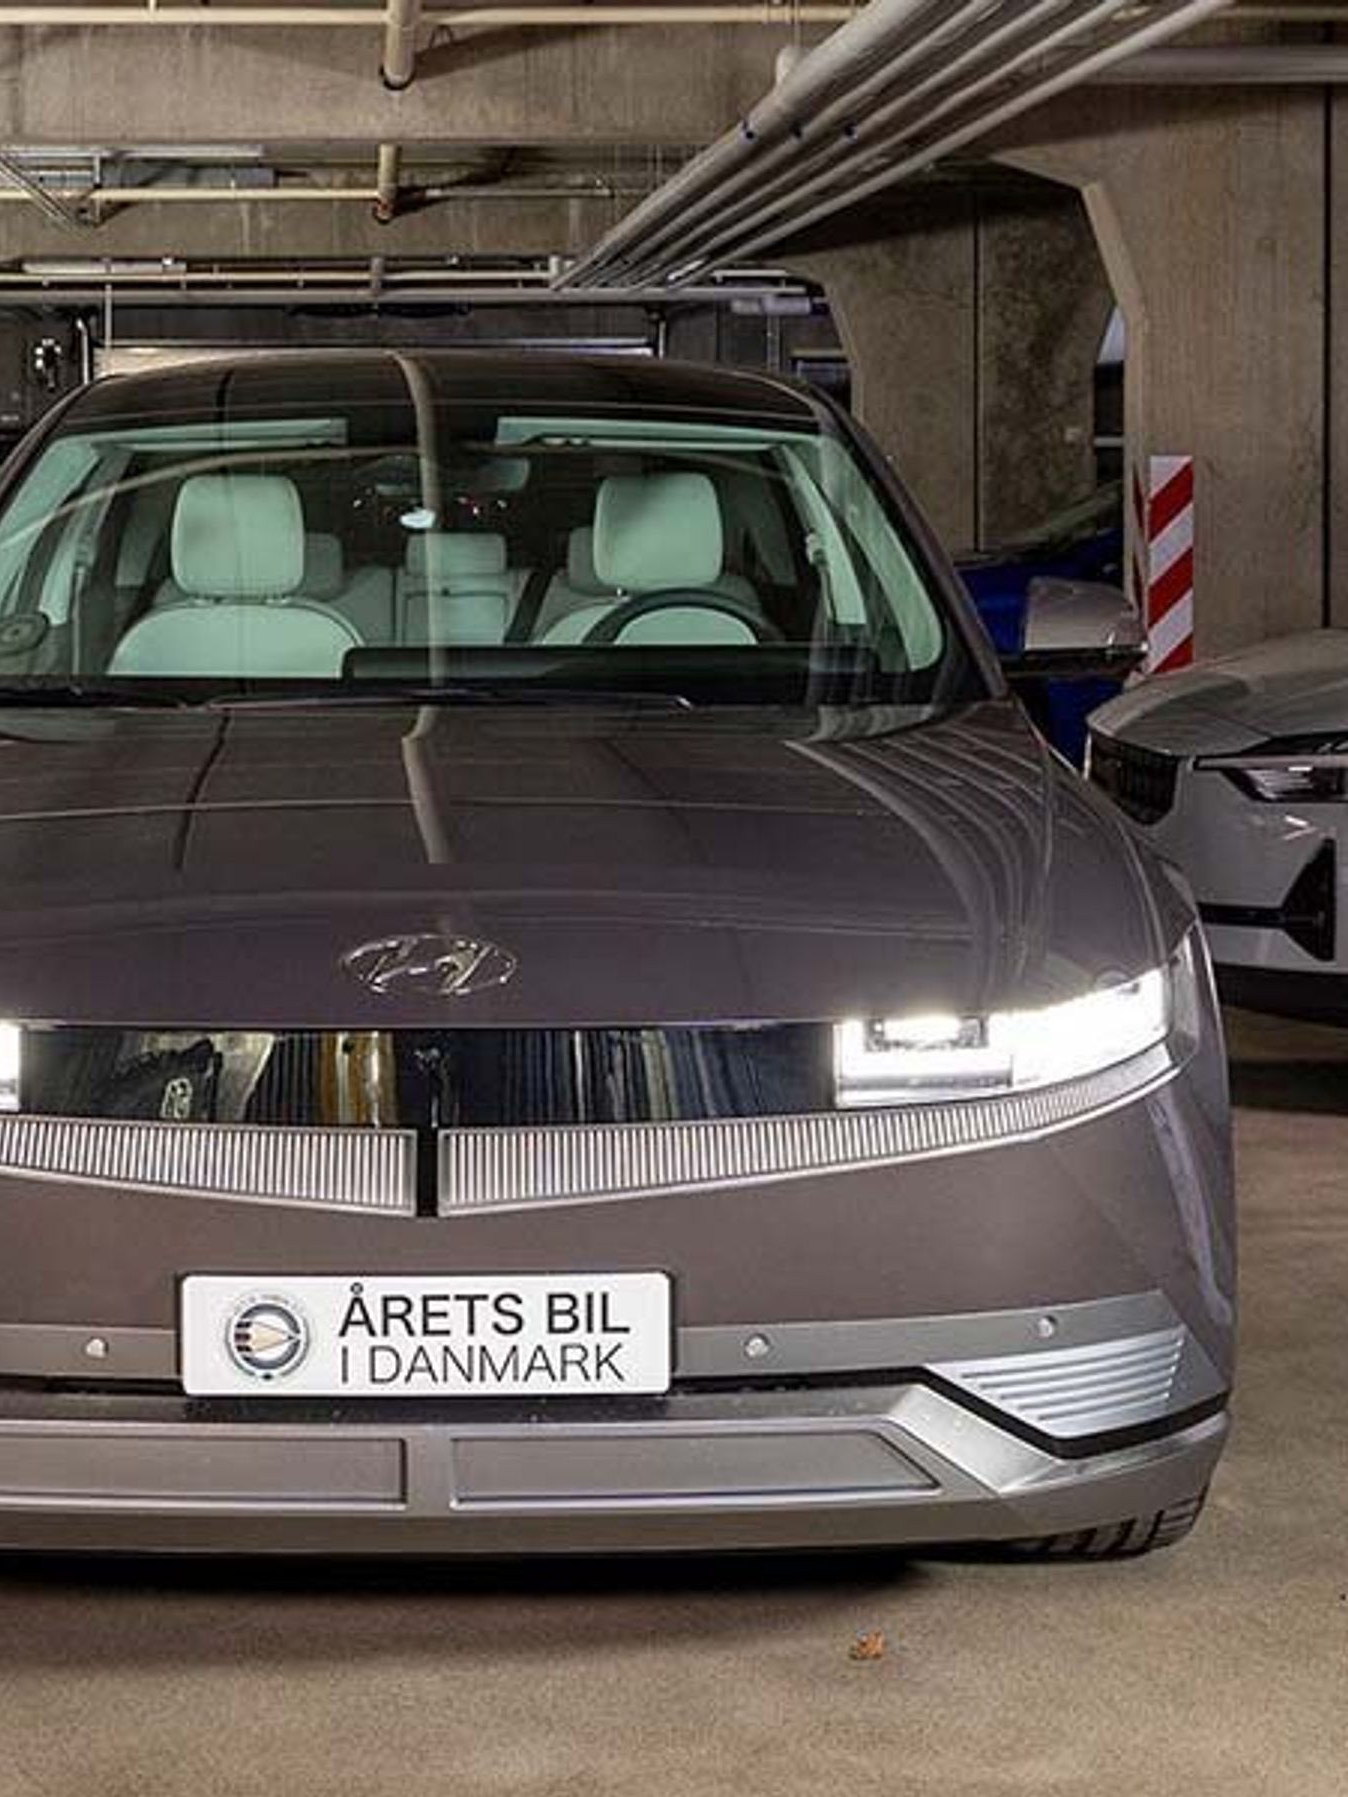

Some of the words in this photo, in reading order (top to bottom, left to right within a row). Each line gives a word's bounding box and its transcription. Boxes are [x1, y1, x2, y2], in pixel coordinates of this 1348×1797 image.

[339, 1282, 524, 1337] ÅRETS
[546, 1291, 631, 1334] BIL
[341, 1346, 349, 1383] I
[369, 1342, 626, 1384] DANMARK
